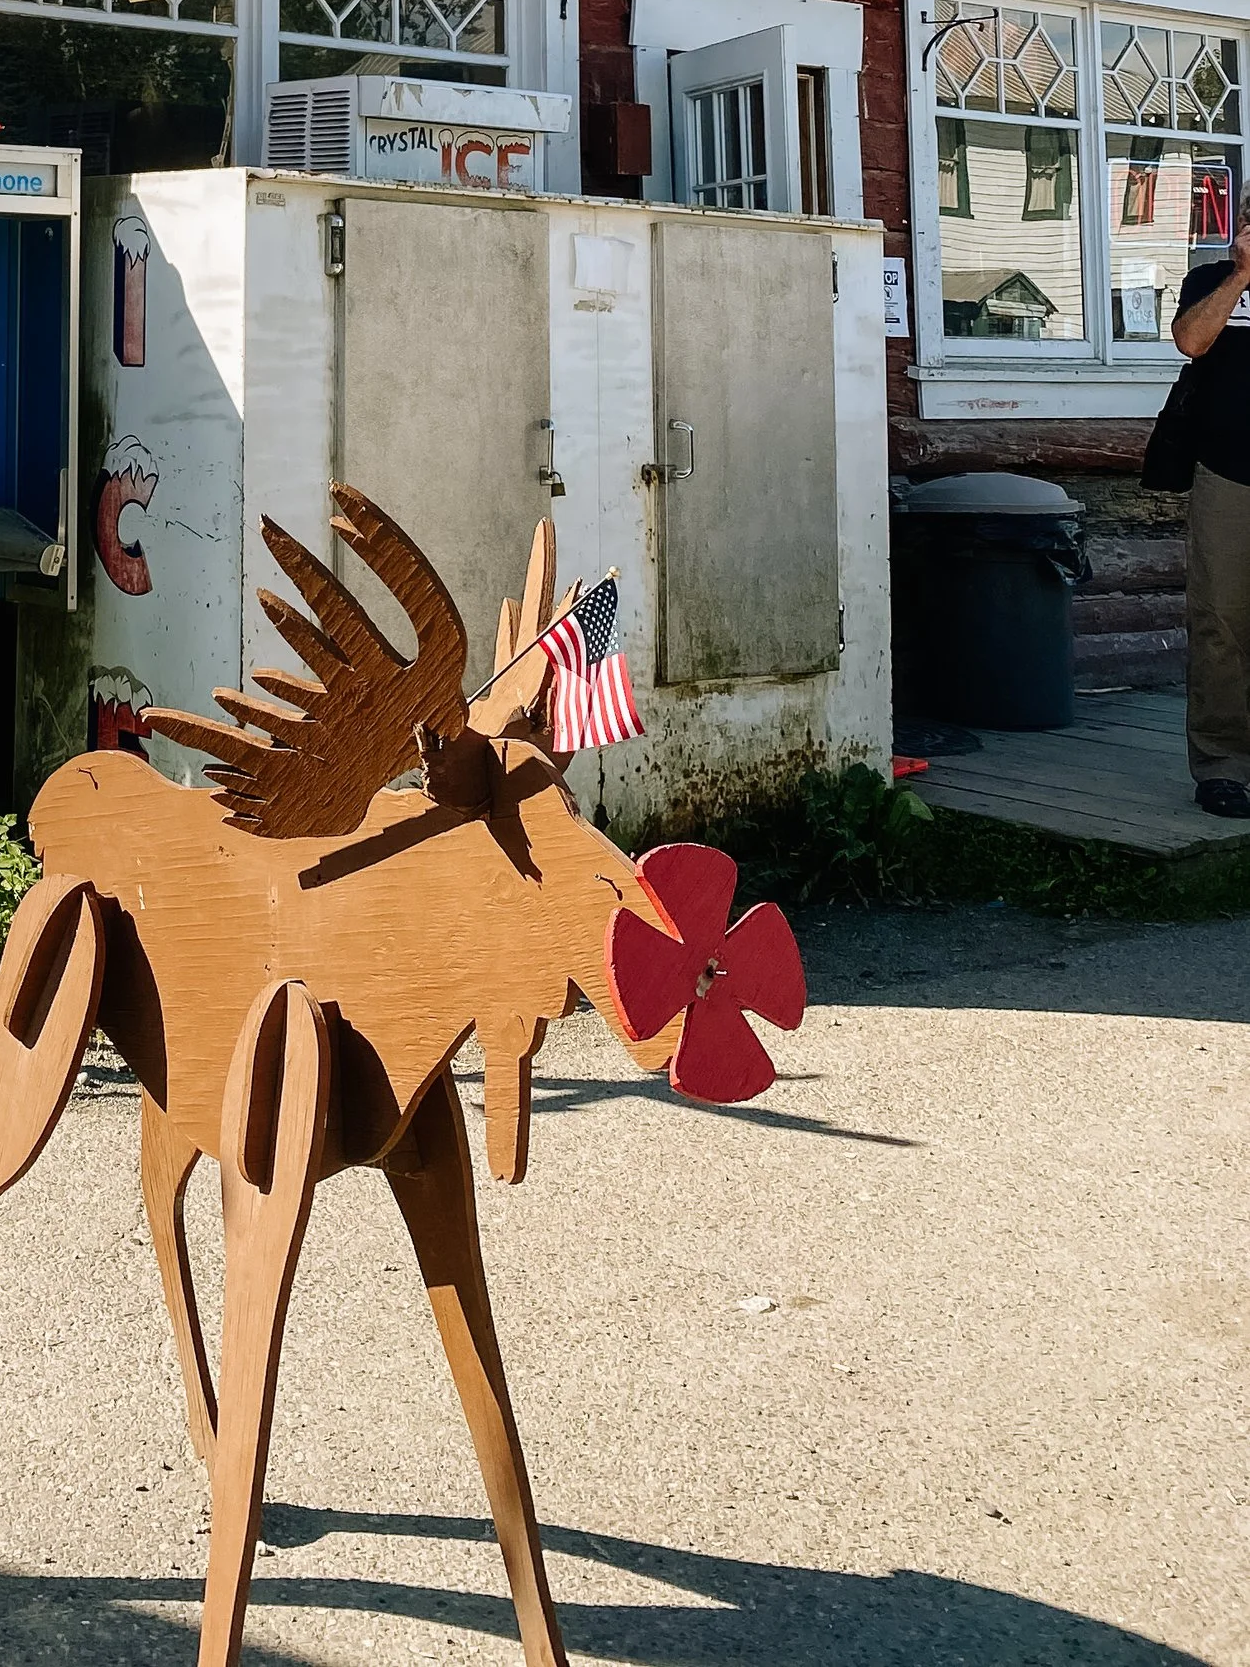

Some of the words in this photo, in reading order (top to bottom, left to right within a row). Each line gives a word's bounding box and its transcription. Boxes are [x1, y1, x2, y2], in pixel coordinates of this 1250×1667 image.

[369, 126, 438, 155] CRYSTAL
[439, 128, 531, 191] ICE
[885, 272, 898, 284] OP
